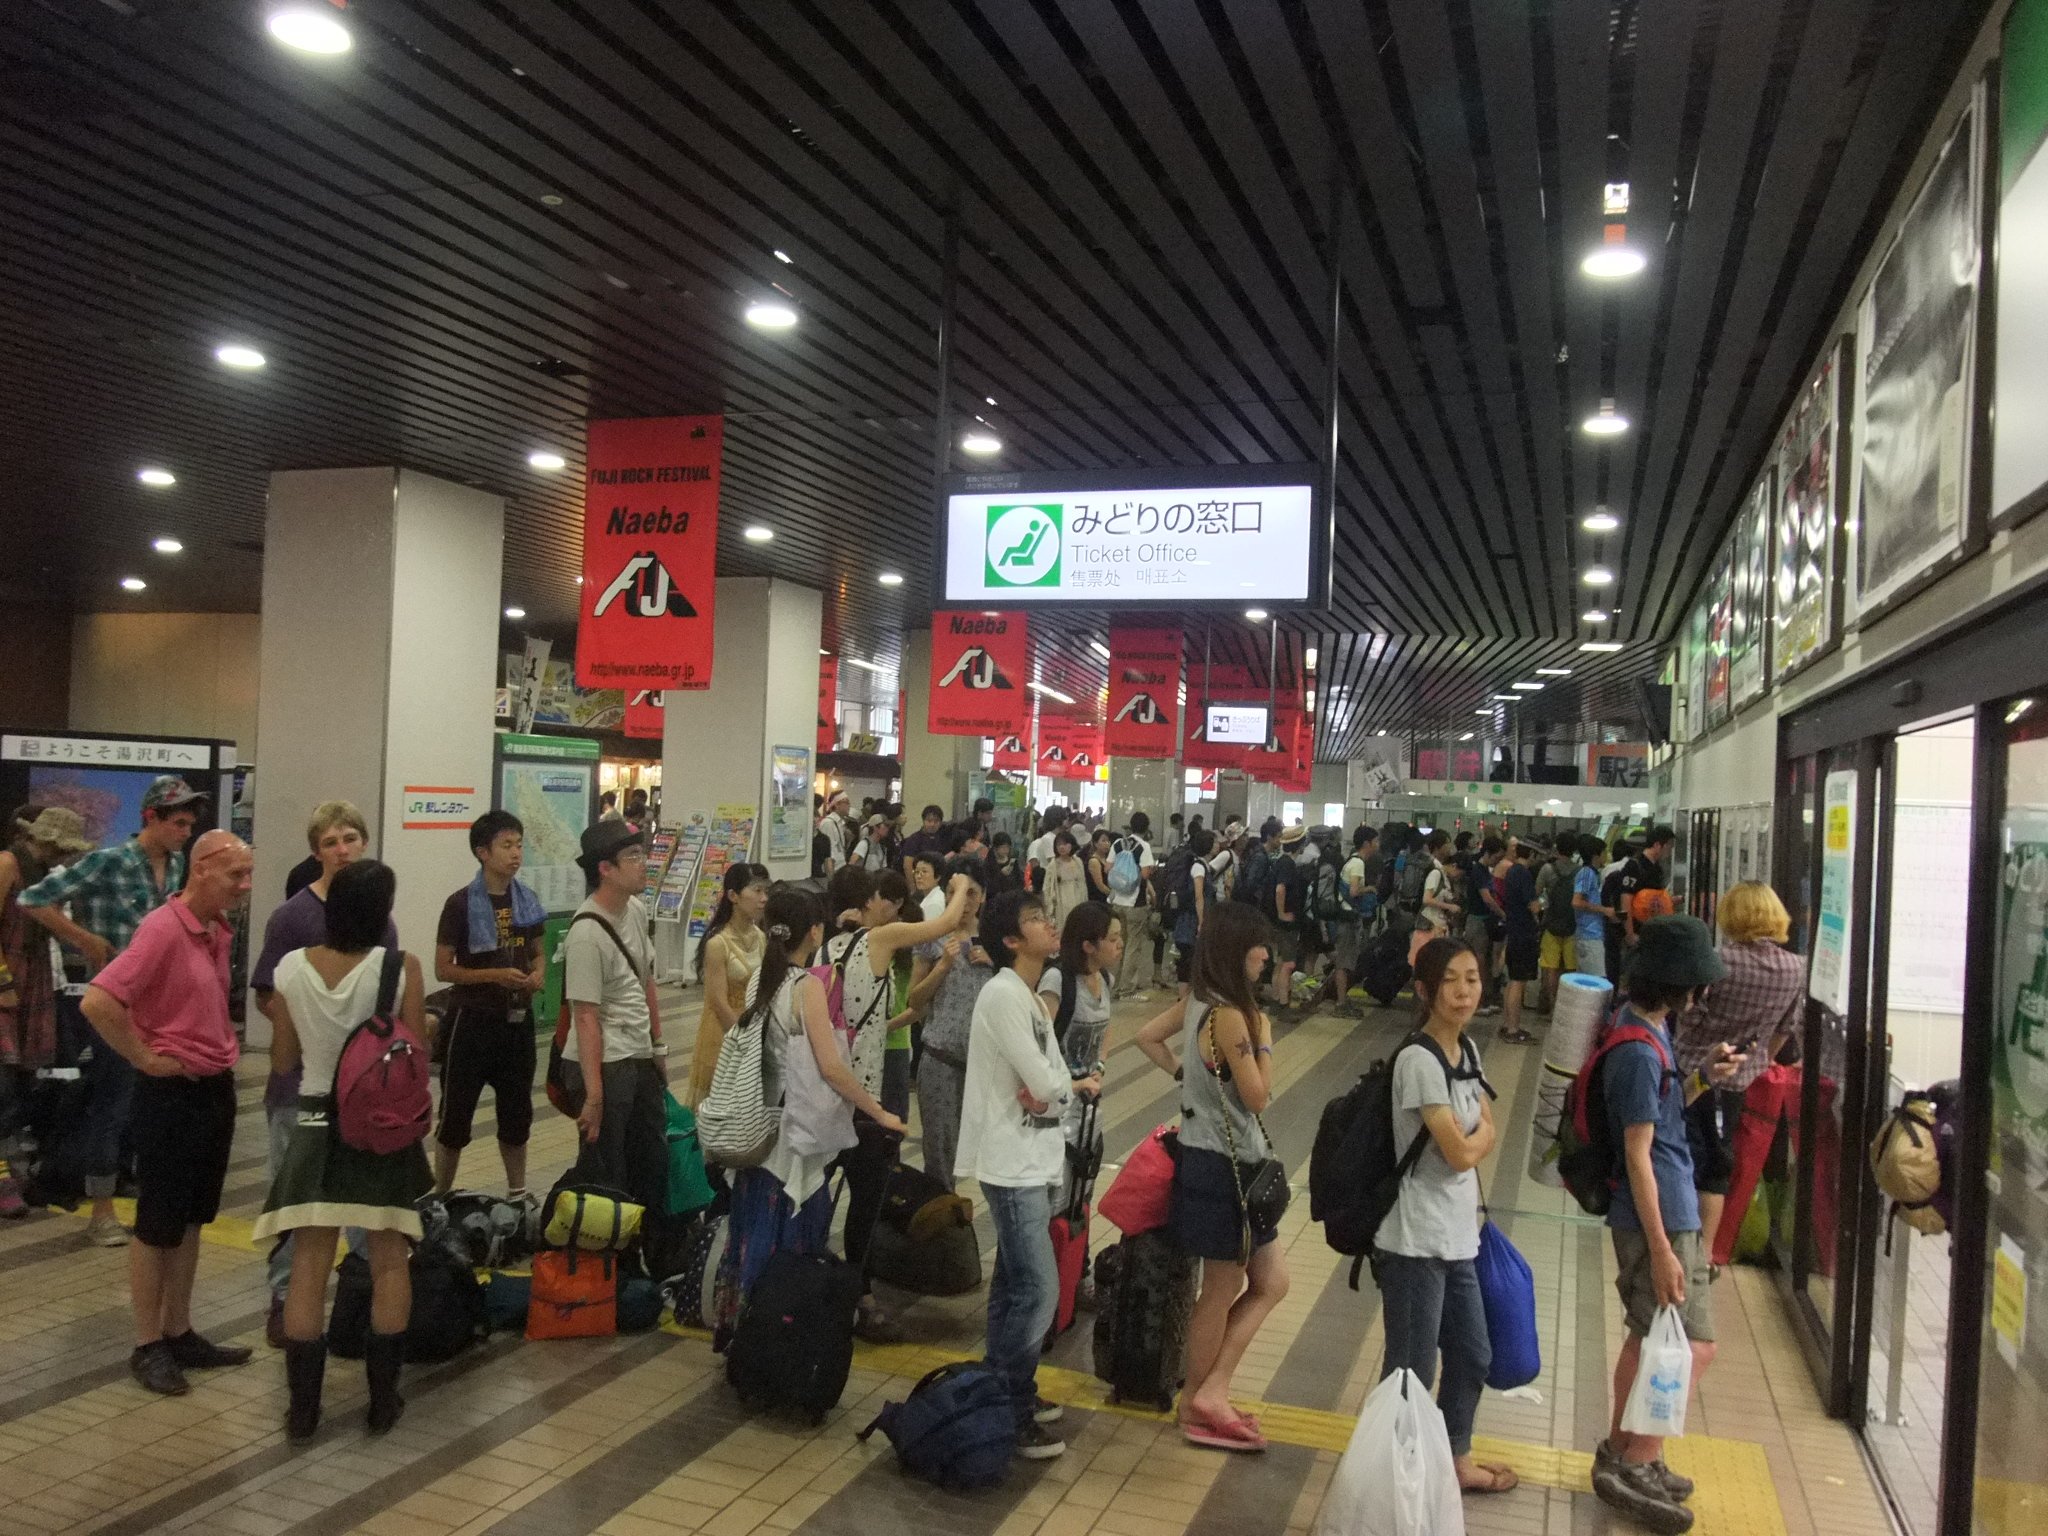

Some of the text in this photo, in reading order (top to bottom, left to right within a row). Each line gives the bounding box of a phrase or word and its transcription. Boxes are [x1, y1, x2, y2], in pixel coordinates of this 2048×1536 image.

[592, 464, 711, 485] FUJI ROCK FESTIVAL
[606, 506, 689, 535] Naeba
[1071, 500, 1263, 535] みどりの窓口
[1070, 544, 1198, 562] Ticket Office
[1136, 568, 1187, 585] 매표소
[950, 616, 1008, 635] Naeba
[46, 743, 193, 762] ようこそ湯沢町へ
[409, 802, 424, 813] JR
